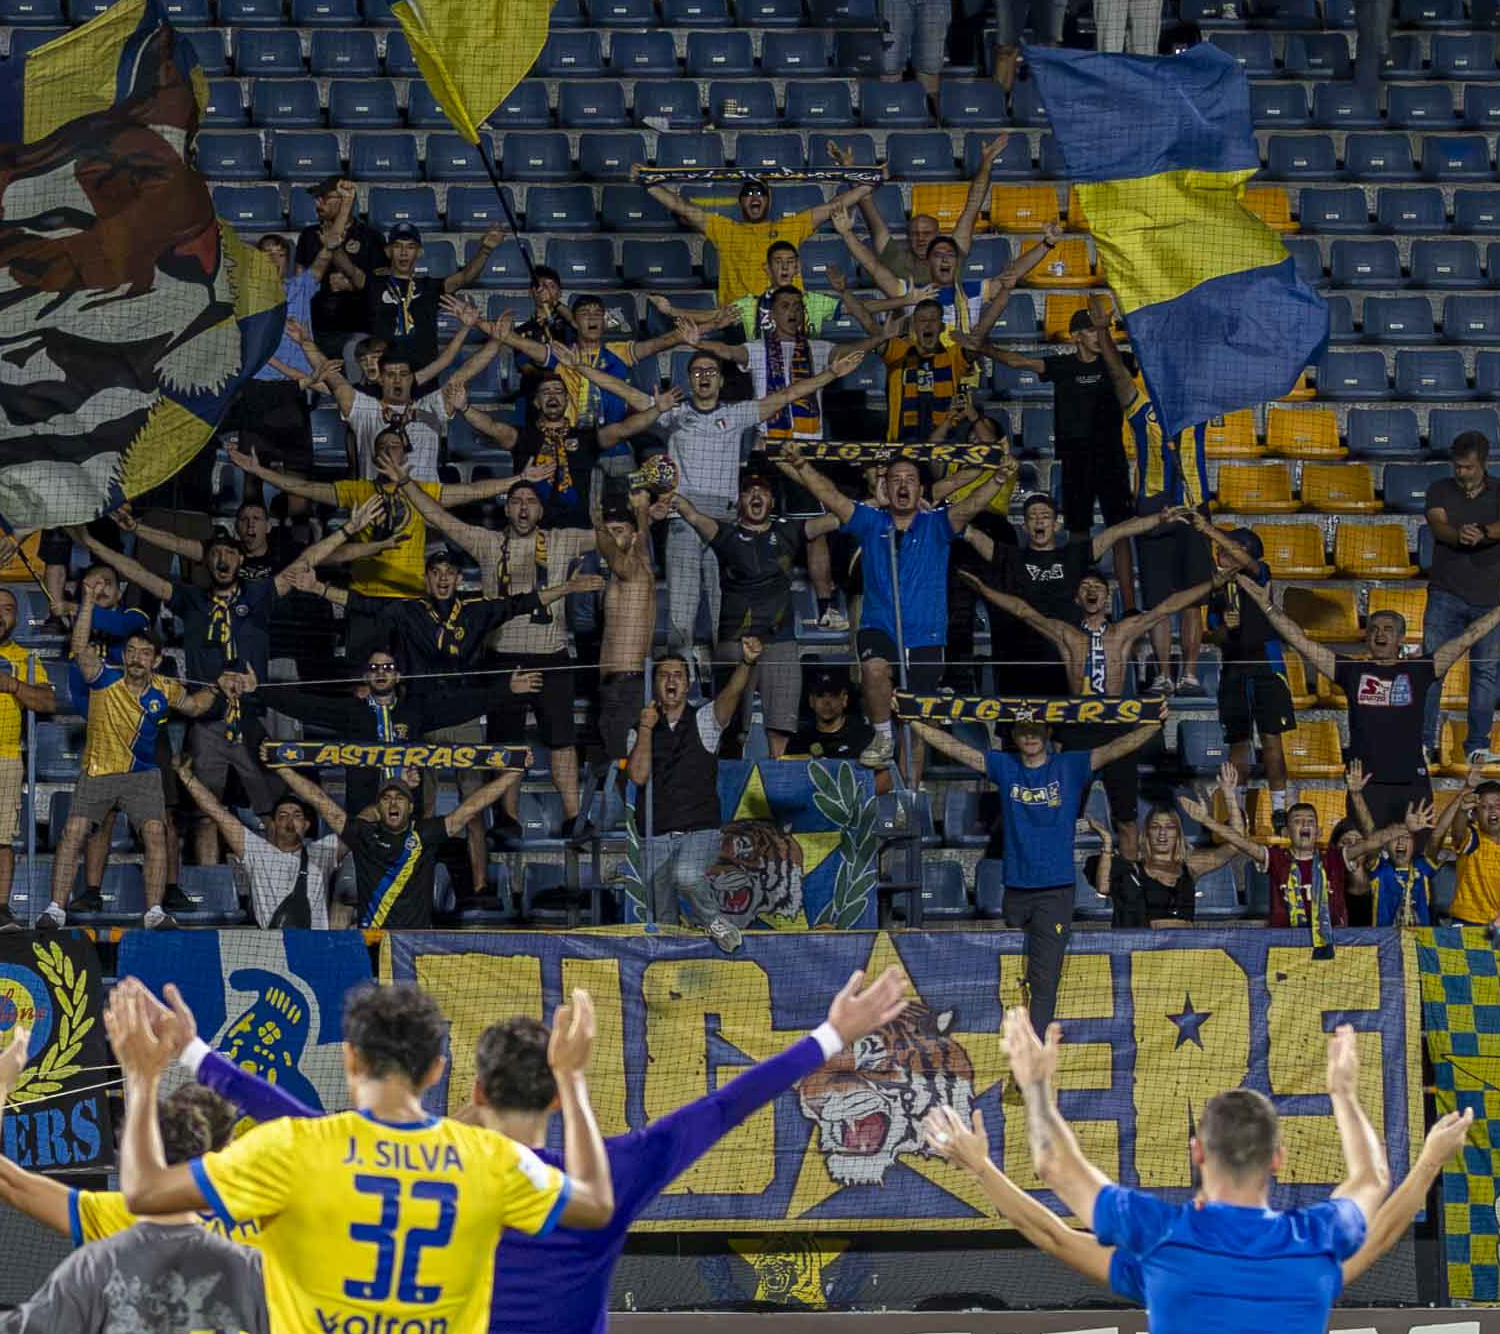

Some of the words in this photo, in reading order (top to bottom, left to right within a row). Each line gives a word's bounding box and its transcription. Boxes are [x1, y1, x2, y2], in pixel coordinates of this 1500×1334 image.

[914, 697, 1143, 724] TIGERS
[314, 743, 476, 768] ASTERAS
[342, 1143, 365, 1170] J.
[372, 1141, 465, 1173] SILVA
[343, 1173, 458, 1304] 32
